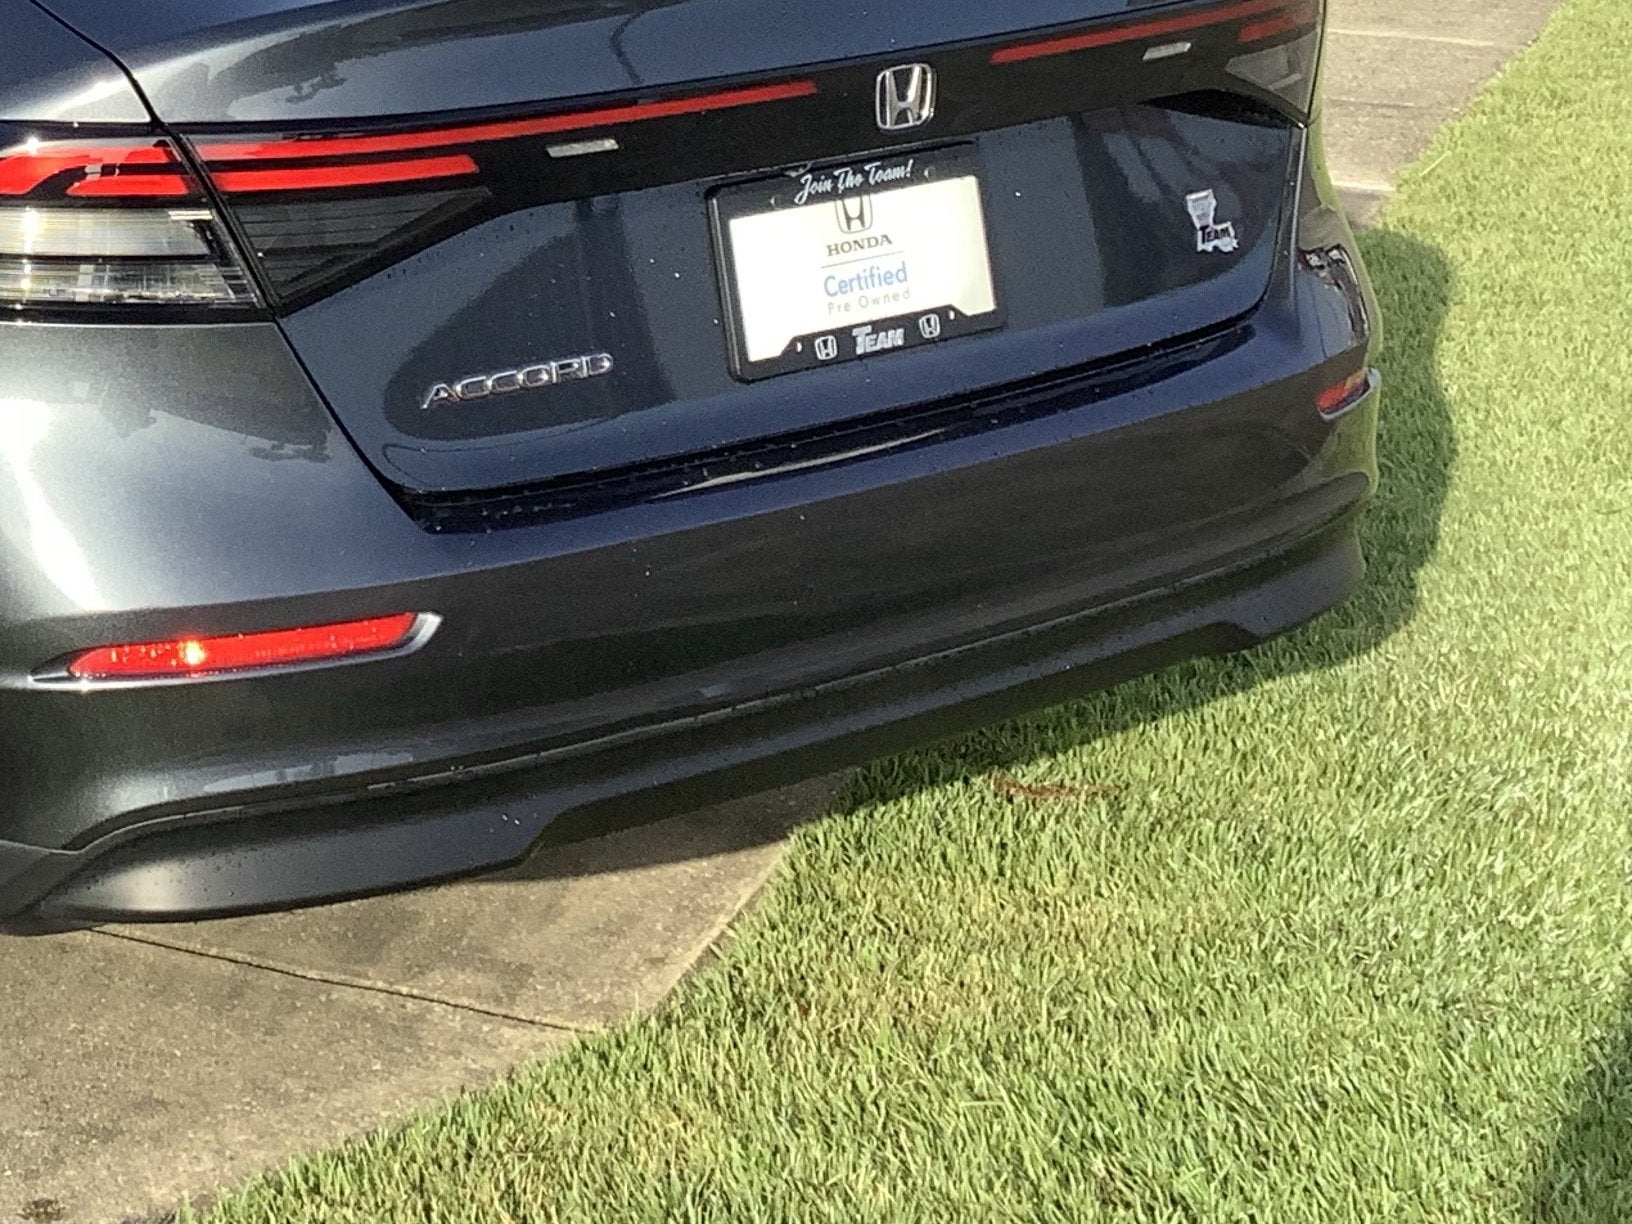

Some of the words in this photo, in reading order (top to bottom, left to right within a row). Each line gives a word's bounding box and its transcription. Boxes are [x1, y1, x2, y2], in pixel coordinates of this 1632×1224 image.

[794, 173, 834, 205] Join
[825, 233, 894, 257] HONDA
[823, 260, 909, 298] Certified
[827, 301, 851, 315] Pre
[858, 287, 911, 309] Owned
[420, 352, 614, 410] ACCORD
